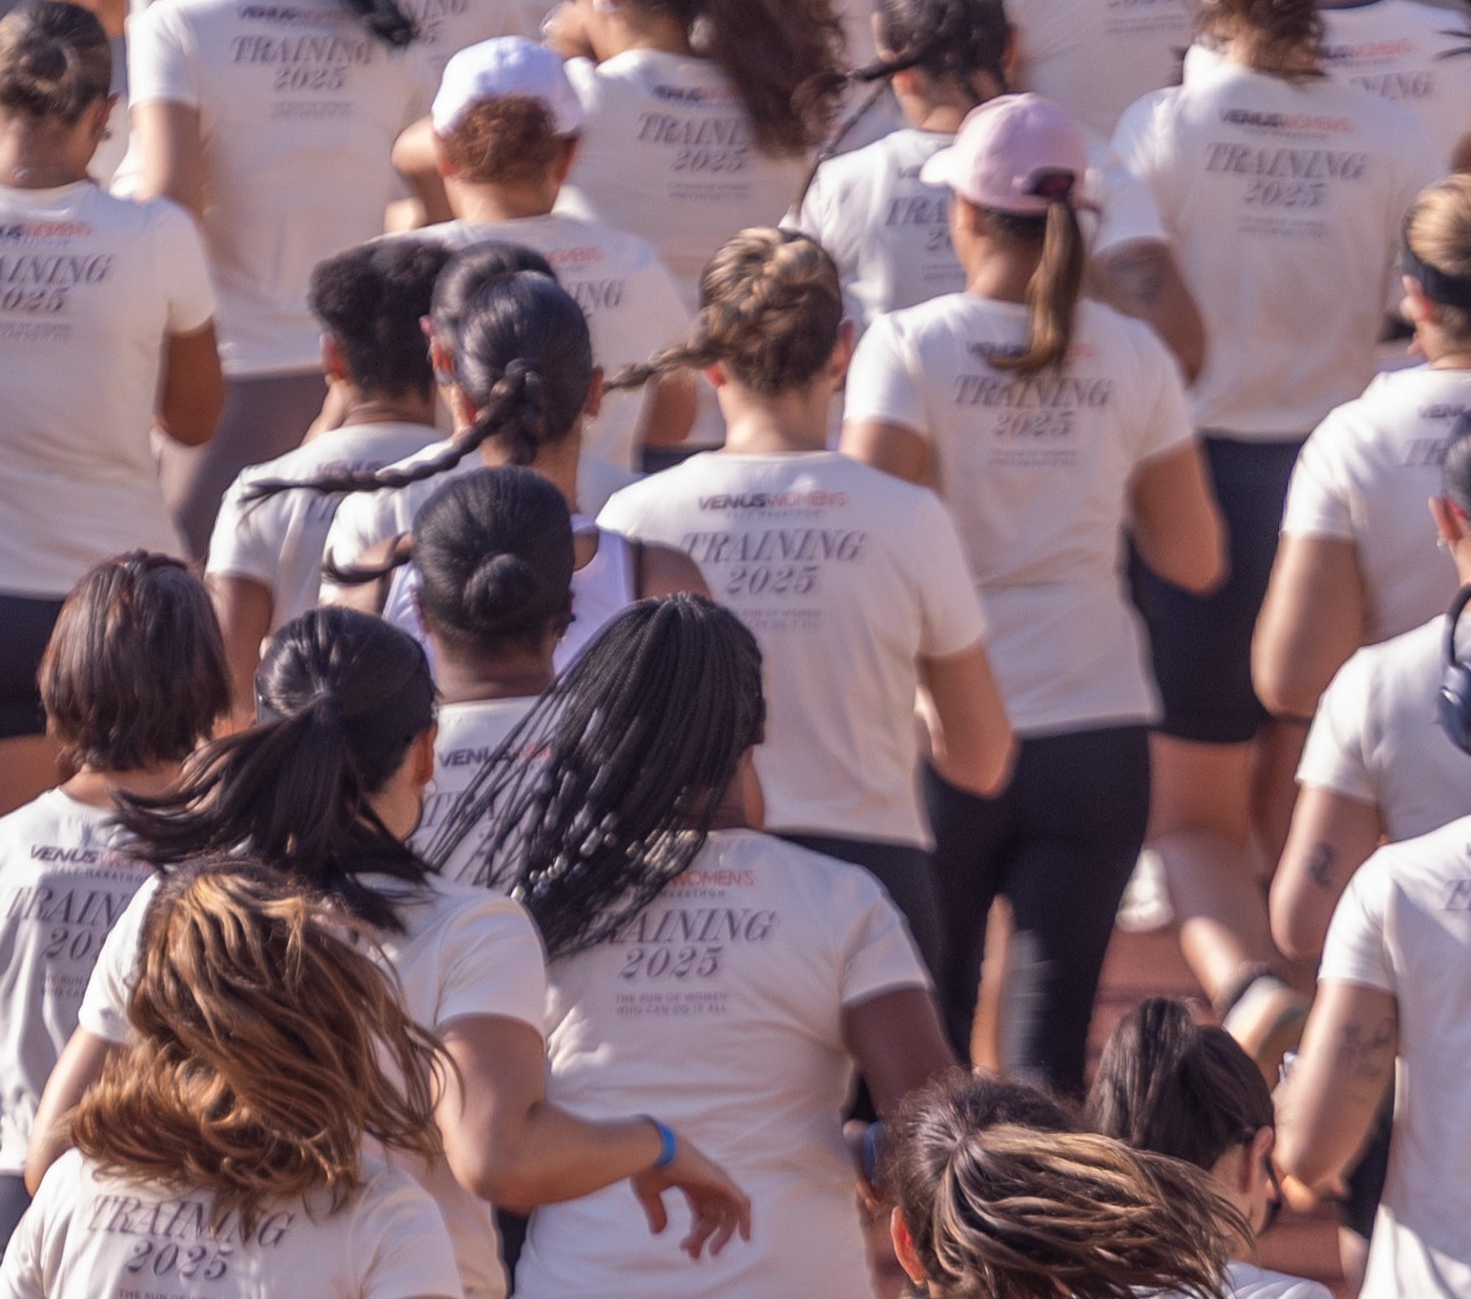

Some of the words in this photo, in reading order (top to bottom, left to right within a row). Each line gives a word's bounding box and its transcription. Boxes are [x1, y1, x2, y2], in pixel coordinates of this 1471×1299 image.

[683, 528, 868, 564] TRAINING
[723, 564, 818, 595] 2025
[617, 945, 725, 980] 2025
[124, 1240, 234, 1282] 2025
